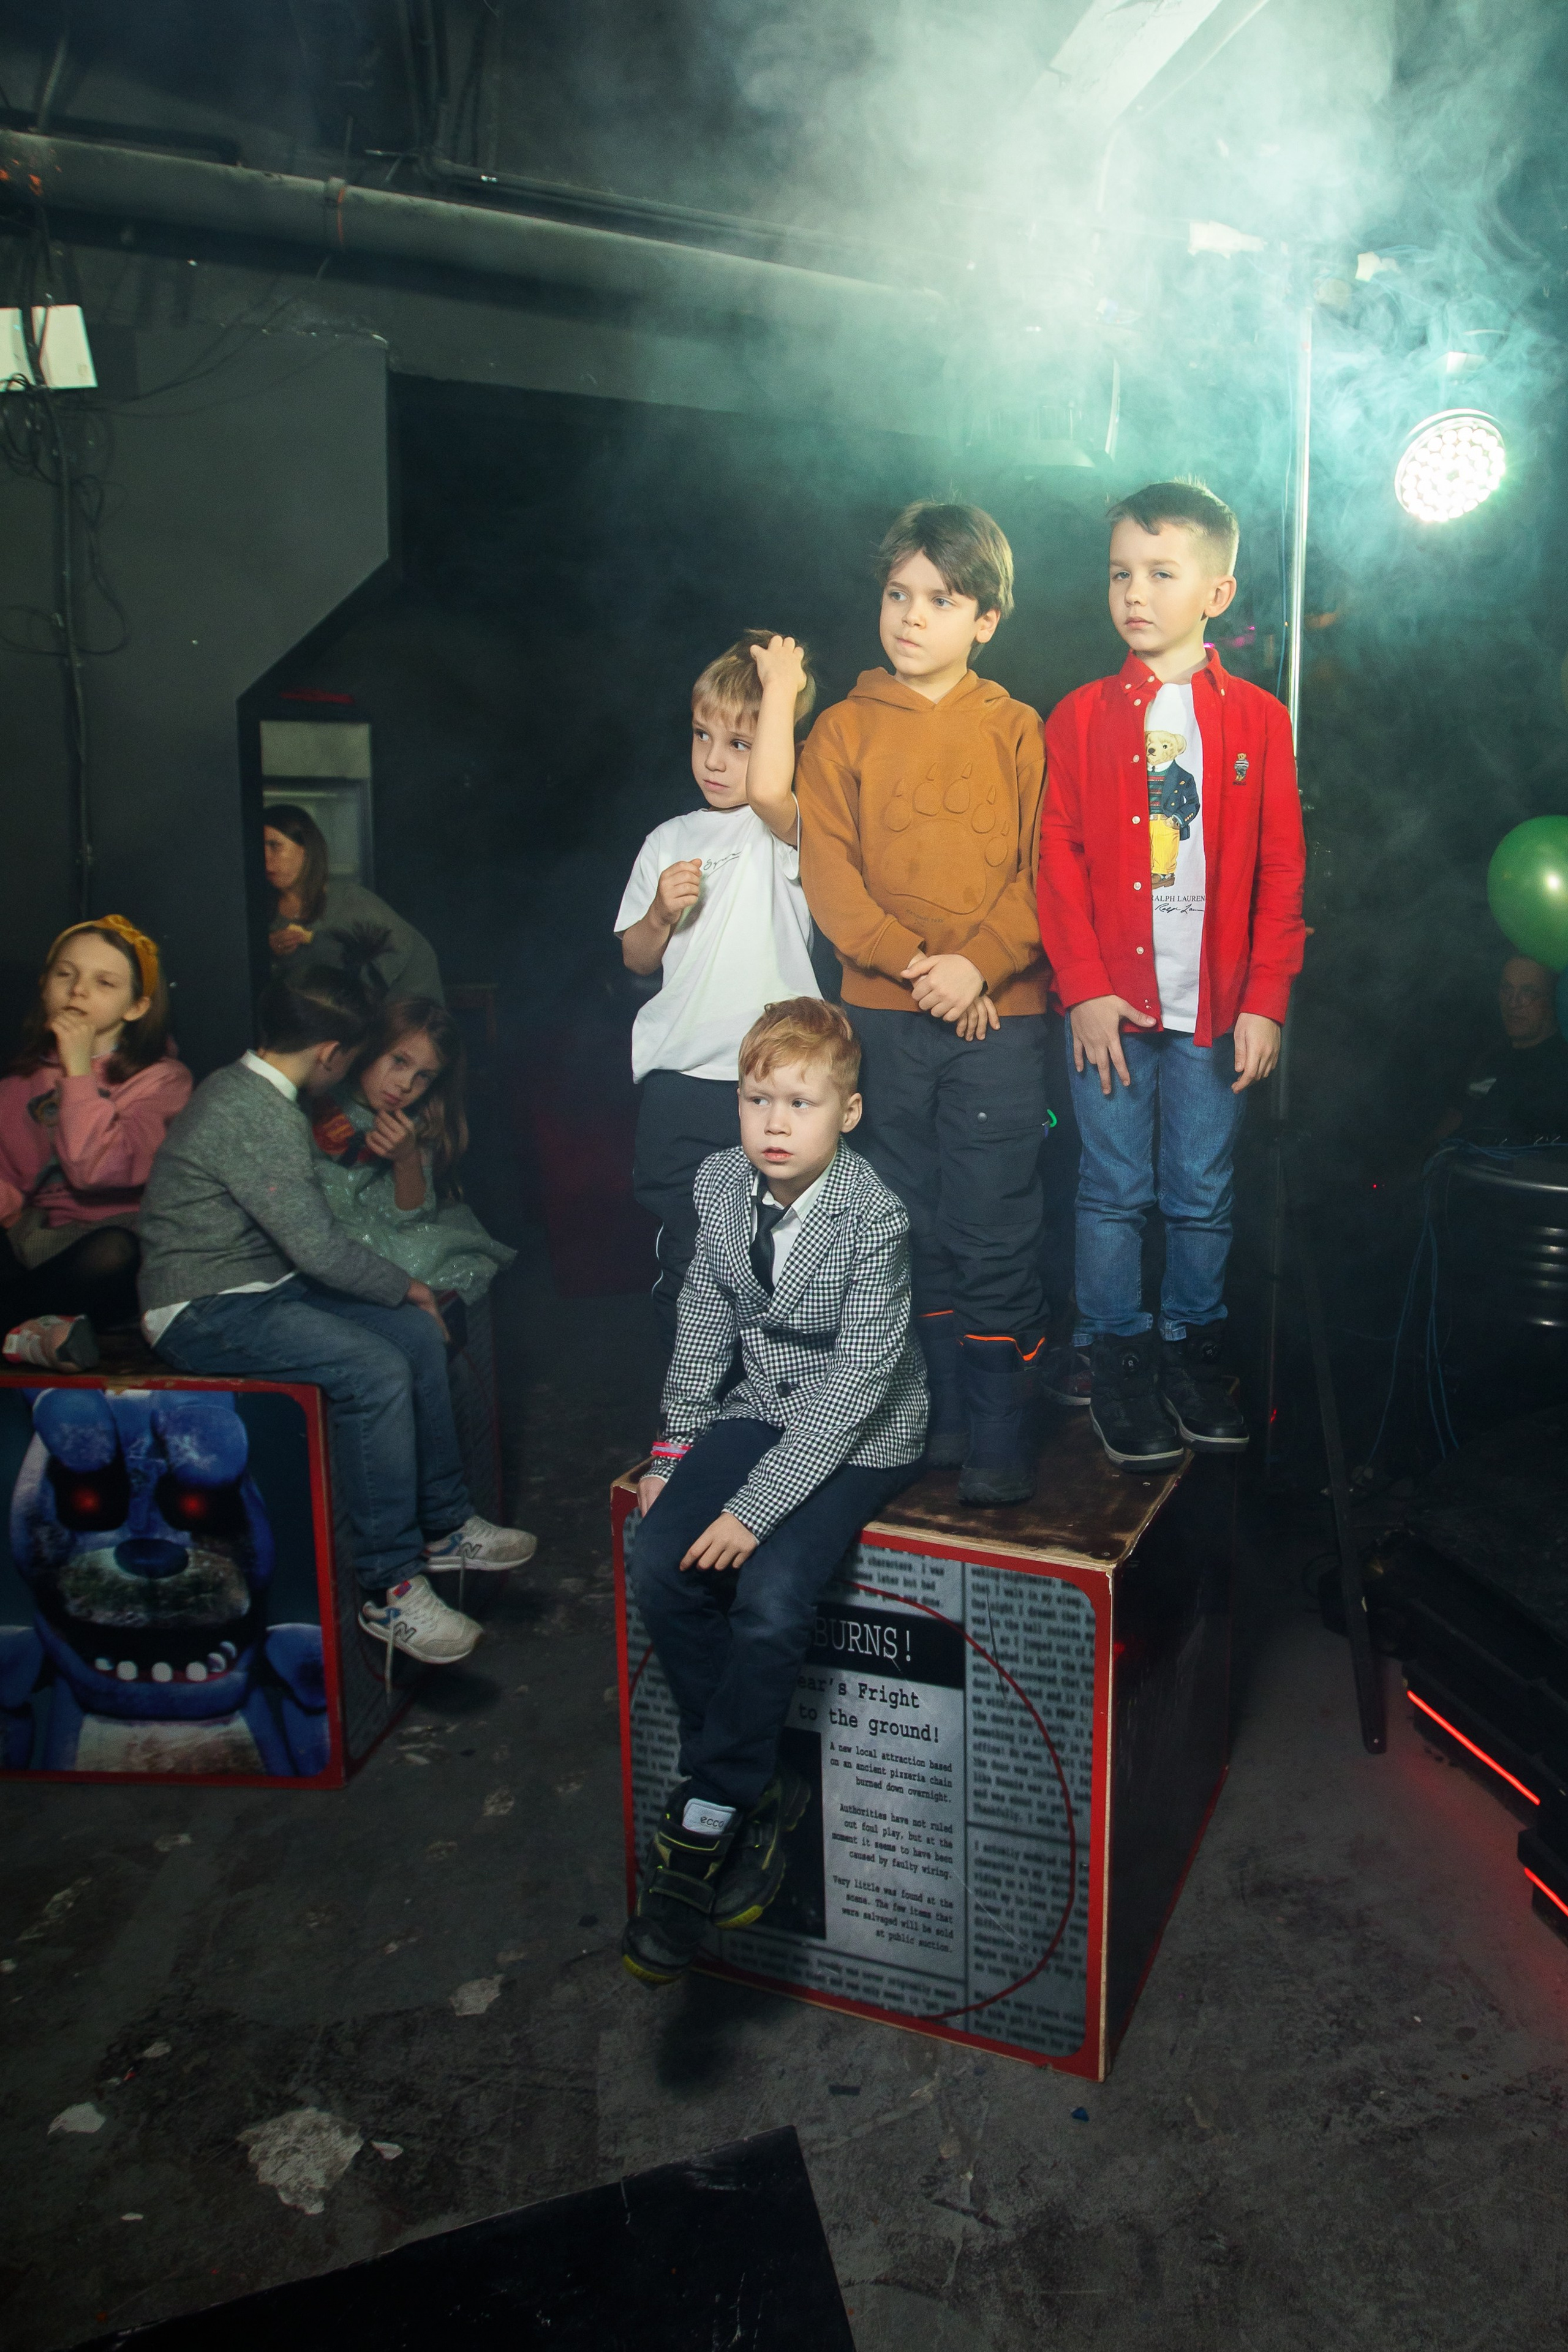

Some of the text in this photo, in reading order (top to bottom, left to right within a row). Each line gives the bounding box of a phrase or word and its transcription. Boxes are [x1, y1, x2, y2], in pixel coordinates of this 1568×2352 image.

[814, 1616, 911, 1662] BURNS!
[858, 1682, 920, 1709] Fright
[799, 1703, 939, 1743] to the ground!
[829, 1741, 952, 1772] A new local attraction based
[856, 1760, 886, 1775] ancient
[890, 1767, 925, 1785] pizzeria
[929, 1774, 952, 1787] chain
[856, 1776, 882, 1789] burned
[886, 1782, 903, 1793] down
[699, 1815, 724, 1828] ecco
[840, 1803, 952, 1833] Authorities have not ruled
[844, 1819, 857, 1829] out
[861, 1822, 877, 1833] foul
[908, 1832, 922, 1842] but
[926, 1836, 935, 1845] at
[940, 1838, 952, 1849] the
[862, 1836, 870, 1847] it
[900, 1845, 909, 1855] to
[913, 1847, 930, 1860] have
[935, 1852, 952, 1864] been
